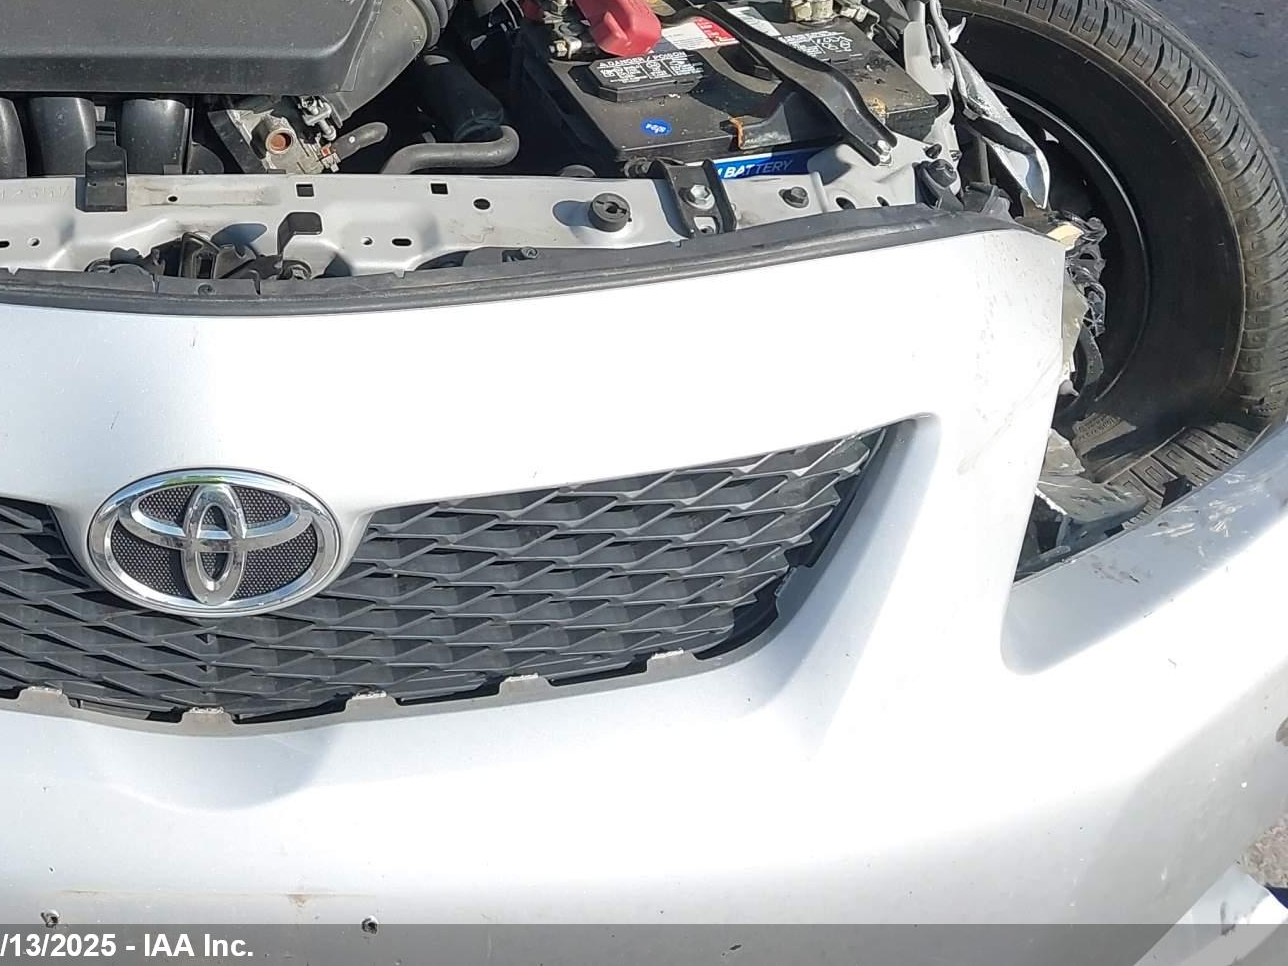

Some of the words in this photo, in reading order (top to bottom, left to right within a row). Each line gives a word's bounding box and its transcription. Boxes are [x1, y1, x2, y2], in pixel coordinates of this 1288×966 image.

[607, 57, 644, 66] DANGER
[652, 51, 688, 60] POISON
[724, 160, 792, 178] BATTERY
